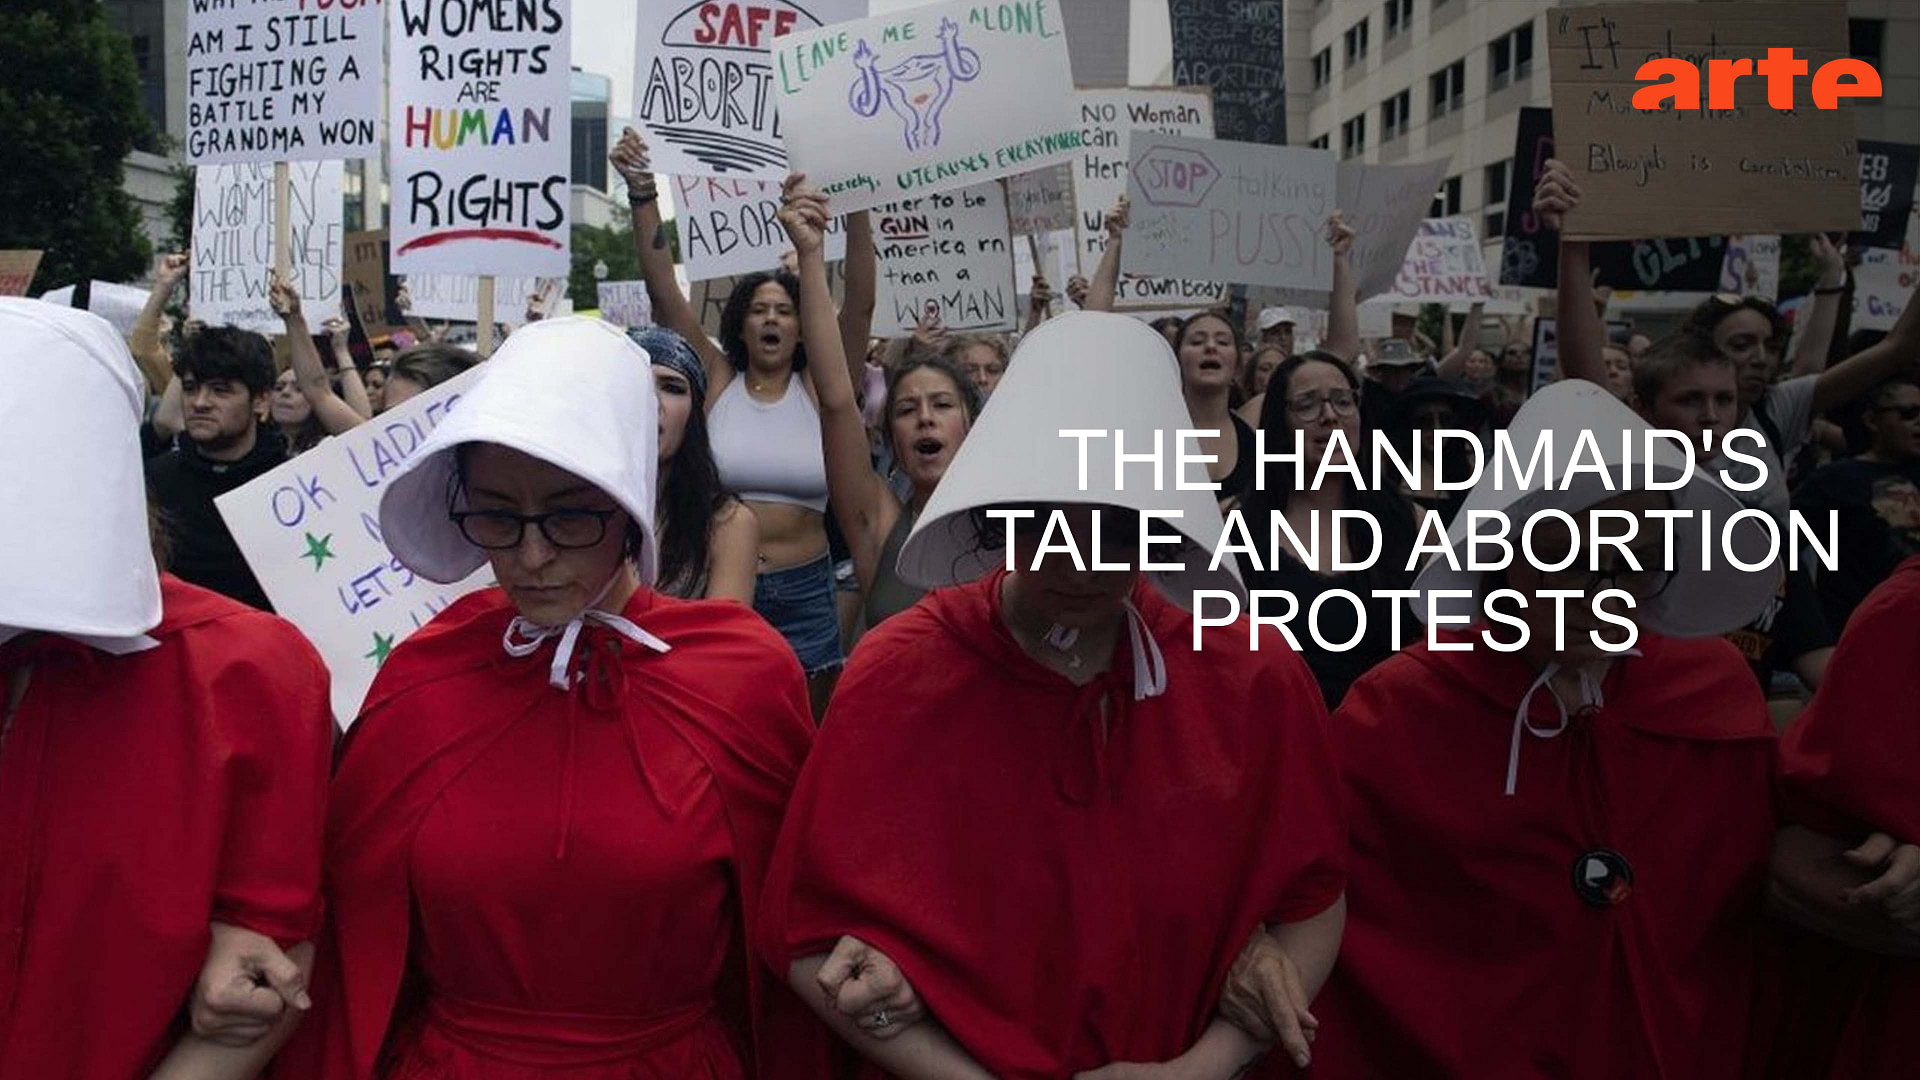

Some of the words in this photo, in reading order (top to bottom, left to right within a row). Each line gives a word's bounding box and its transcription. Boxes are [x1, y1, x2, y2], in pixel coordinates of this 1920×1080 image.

[187, 29, 223, 57] AM
[234, 24, 253, 51] I
[265, 15, 357, 51] STILL
[401, 0, 563, 38] WOMENS
[694, 3, 798, 47] SAFE
[189, 56, 328, 98] FIGHTING
[338, 55, 360, 82] A
[419, 44, 551, 82] RIGHTS
[779, 32, 850, 94] LEAVE
[882, 22, 916, 44] ME
[189, 97, 275, 127] BATTLE
[292, 91, 326, 115] MY
[457, 81, 502, 103] ARE
[406, 106, 551, 150] HUMAN
[1127, 102, 1201, 125] Woman
[189, 126, 305, 158] GRANDMA
[319, 118, 375, 146] WON
[1082, 127, 1118, 148] can
[1691, 154, 1710, 171] is
[407, 170, 568, 231] RIGHTS
[930, 193, 954, 210] to
[963, 190, 986, 208] be
[1149, 159, 1209, 192] STOP
[1231, 164, 1326, 216] talking
[880, 215, 929, 235] GUN
[937, 217, 954, 231] in
[1209, 209, 1327, 277] PUSSY
[194, 230, 246, 267] WILL
[253, 223, 341, 269] CHNGE
[195, 267, 234, 302] THE
[885, 265, 940, 286] than
[956, 267, 970, 281] a
[272, 474, 337, 527] OK
[338, 553, 414, 615] LET'S
